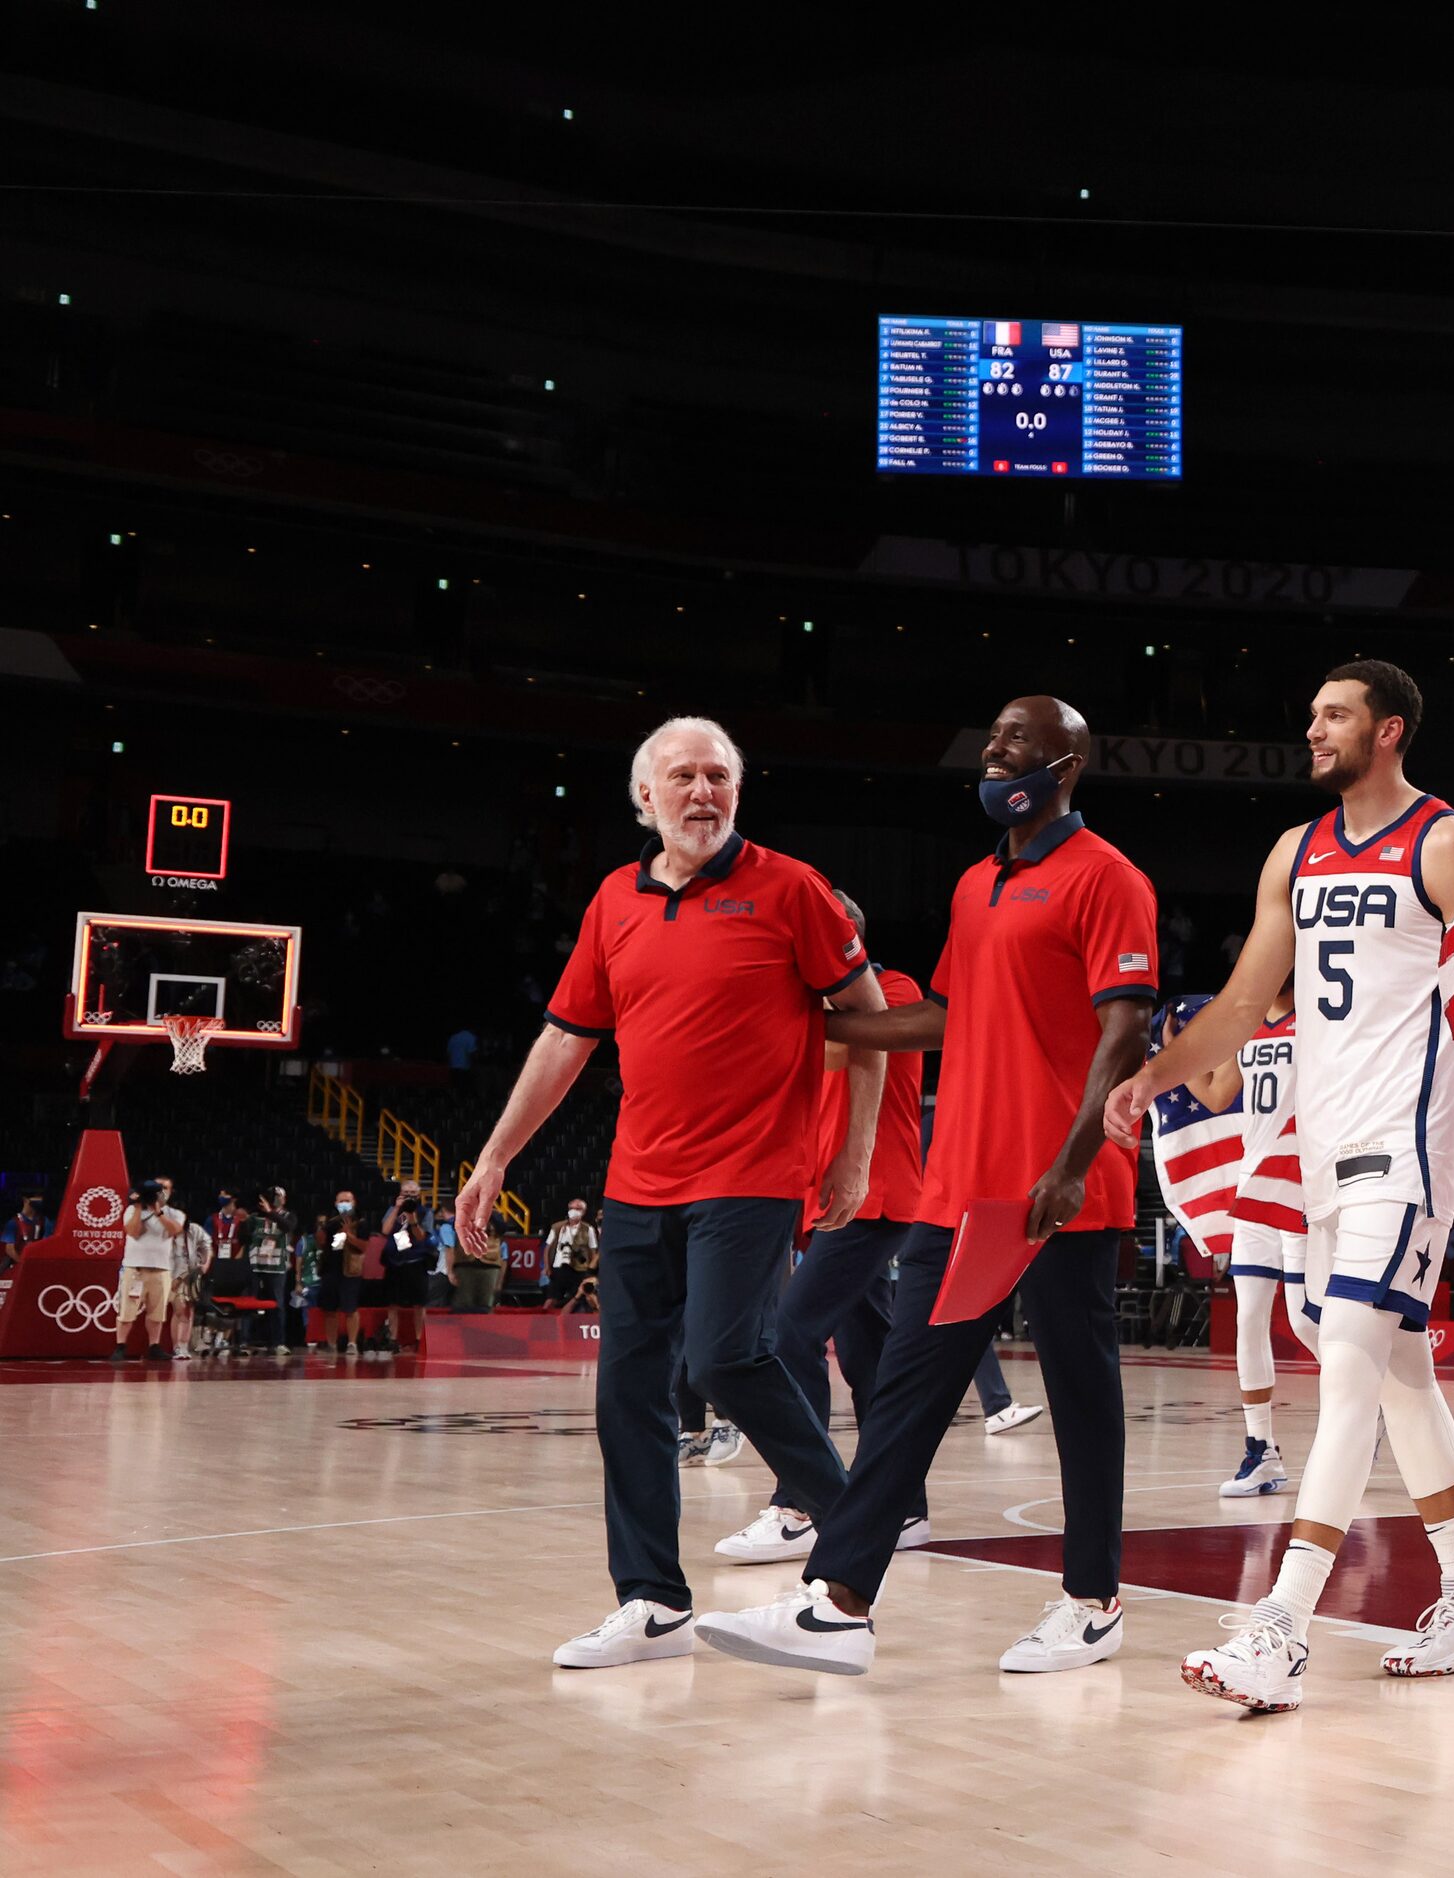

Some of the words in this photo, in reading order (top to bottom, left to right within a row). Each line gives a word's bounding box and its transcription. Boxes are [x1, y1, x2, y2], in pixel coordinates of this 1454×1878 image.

[992, 346, 1013, 357] FRA
[1050, 349, 1071, 359] USA
[990, 361, 1014, 380] 82
[1049, 363, 1073, 381] 87
[1016, 412, 1046, 430] 0.0
[889, 435, 917, 443] GOBERT
[946, 541, 1161, 596] TOKYO
[1182, 560, 1334, 603] 2020
[1099, 738, 1205, 776] KYO
[1223, 744, 1313, 780] 202
[171, 805, 208, 829] 0.0
[167, 877, 218, 891] OMEGA
[1010, 887, 1050, 904] USA
[704, 897, 754, 916] USA
[1296, 885, 1396, 929] USA
[1317, 940, 1354, 1021] 5
[1240, 1042, 1292, 1068] USA
[1251, 1072, 1278, 1115] 10
[72, 1230, 101, 1238] TOKYO
[101, 1231, 124, 1239] 2020
